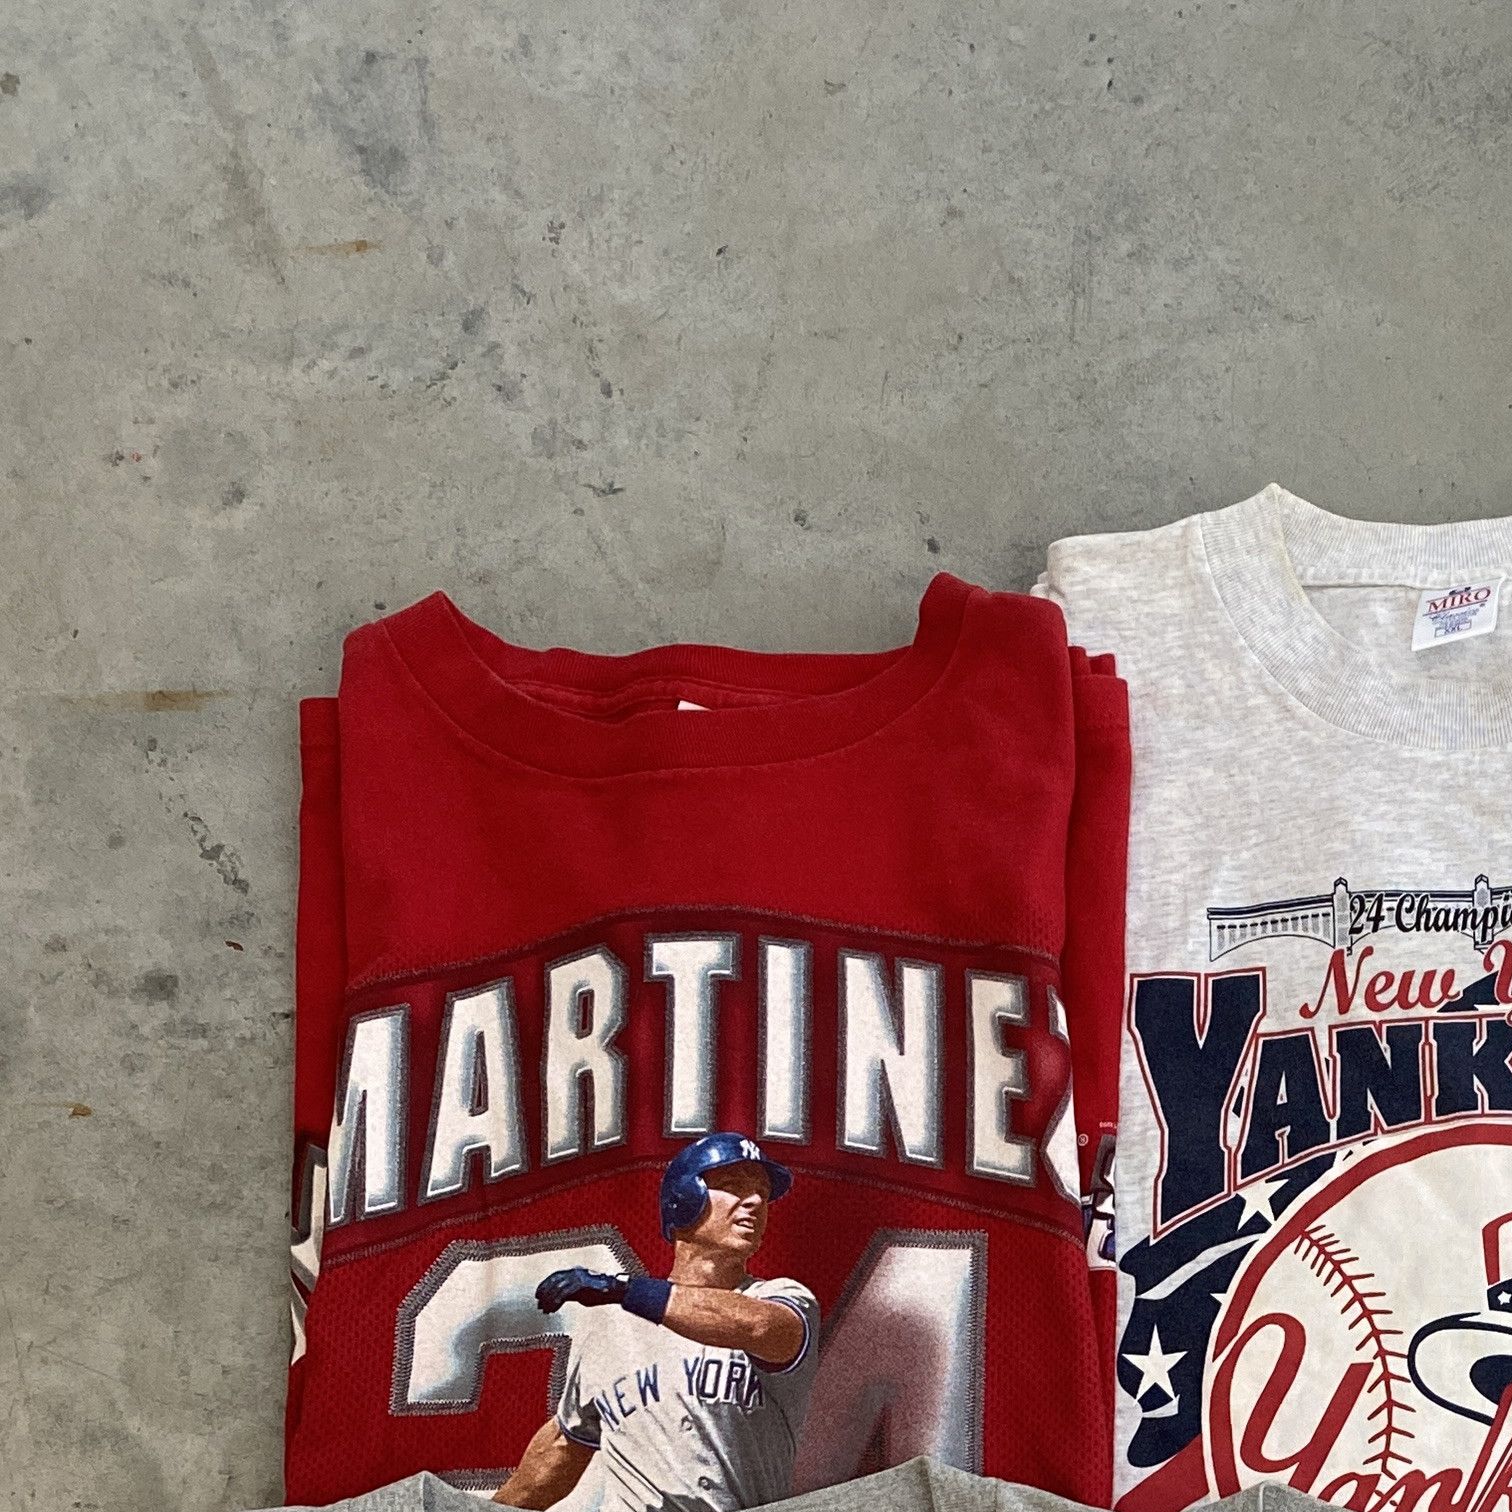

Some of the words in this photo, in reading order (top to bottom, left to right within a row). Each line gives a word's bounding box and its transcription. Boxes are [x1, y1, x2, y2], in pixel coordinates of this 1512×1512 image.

[1427, 586, 1491, 613] MIRO
[1299, 944, 1463, 1019] New
[594, 1364, 661, 1432] NEW
